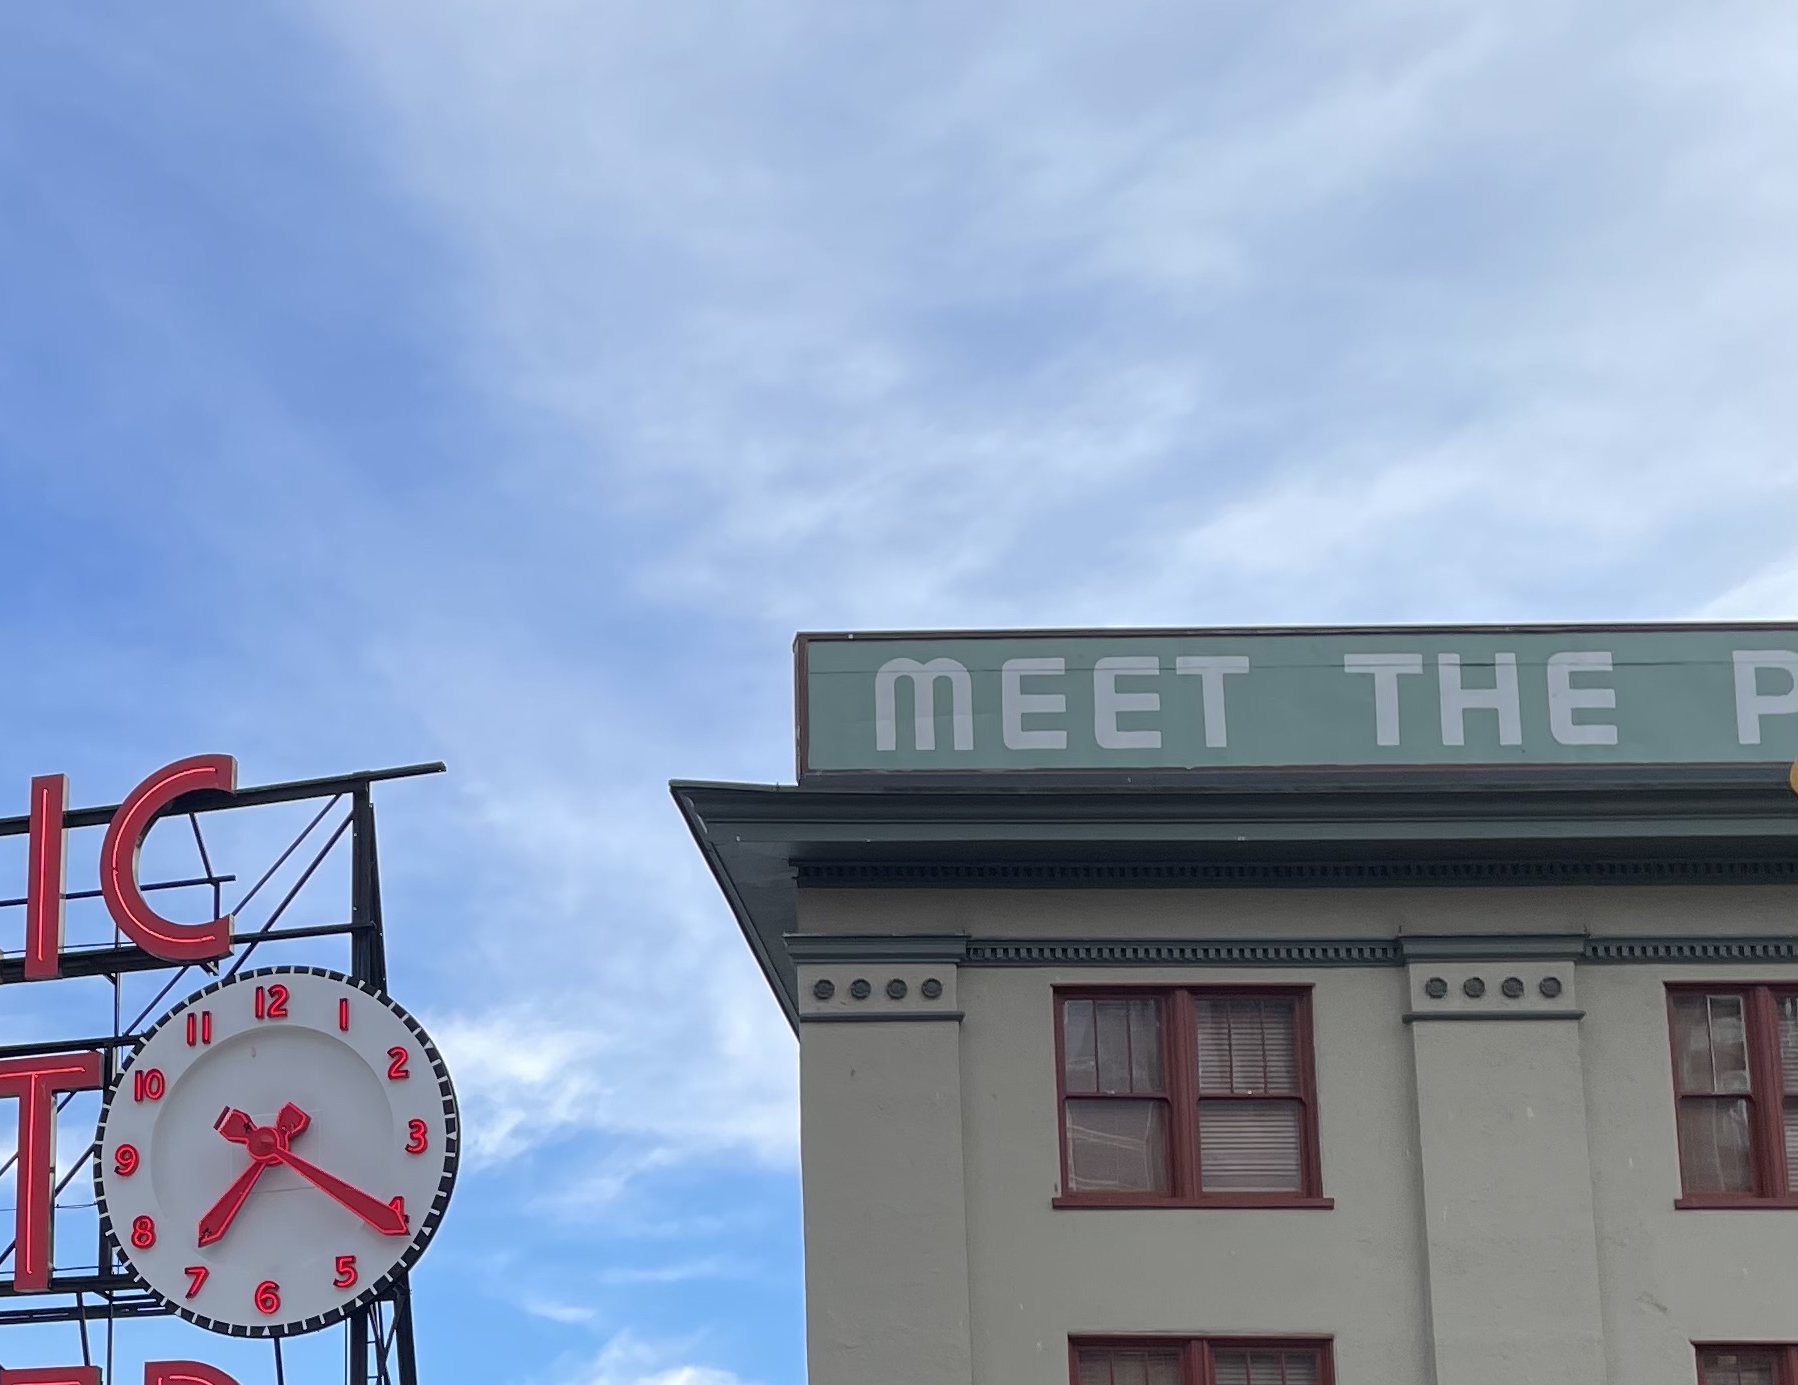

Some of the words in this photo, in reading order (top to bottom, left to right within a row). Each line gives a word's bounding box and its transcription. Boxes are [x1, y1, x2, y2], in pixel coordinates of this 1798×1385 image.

[875, 655, 1250, 751] MEET
[1344, 651, 1618, 748] THE
[255, 984, 289, 1018] 12
[339, 998, 349, 1031] 1
[186, 1010, 211, 1046] 11
[387, 1046, 410, 1080] 2
[134, 1068, 166, 1103] 10
[405, 1119, 428, 1154] 3
[114, 1143, 140, 1177] 9
[131, 1215, 156, 1249] 8
[184, 1266, 210, 1299] 7
[333, 1255, 359, 1288] 5
[255, 1280, 281, 1314] 6
